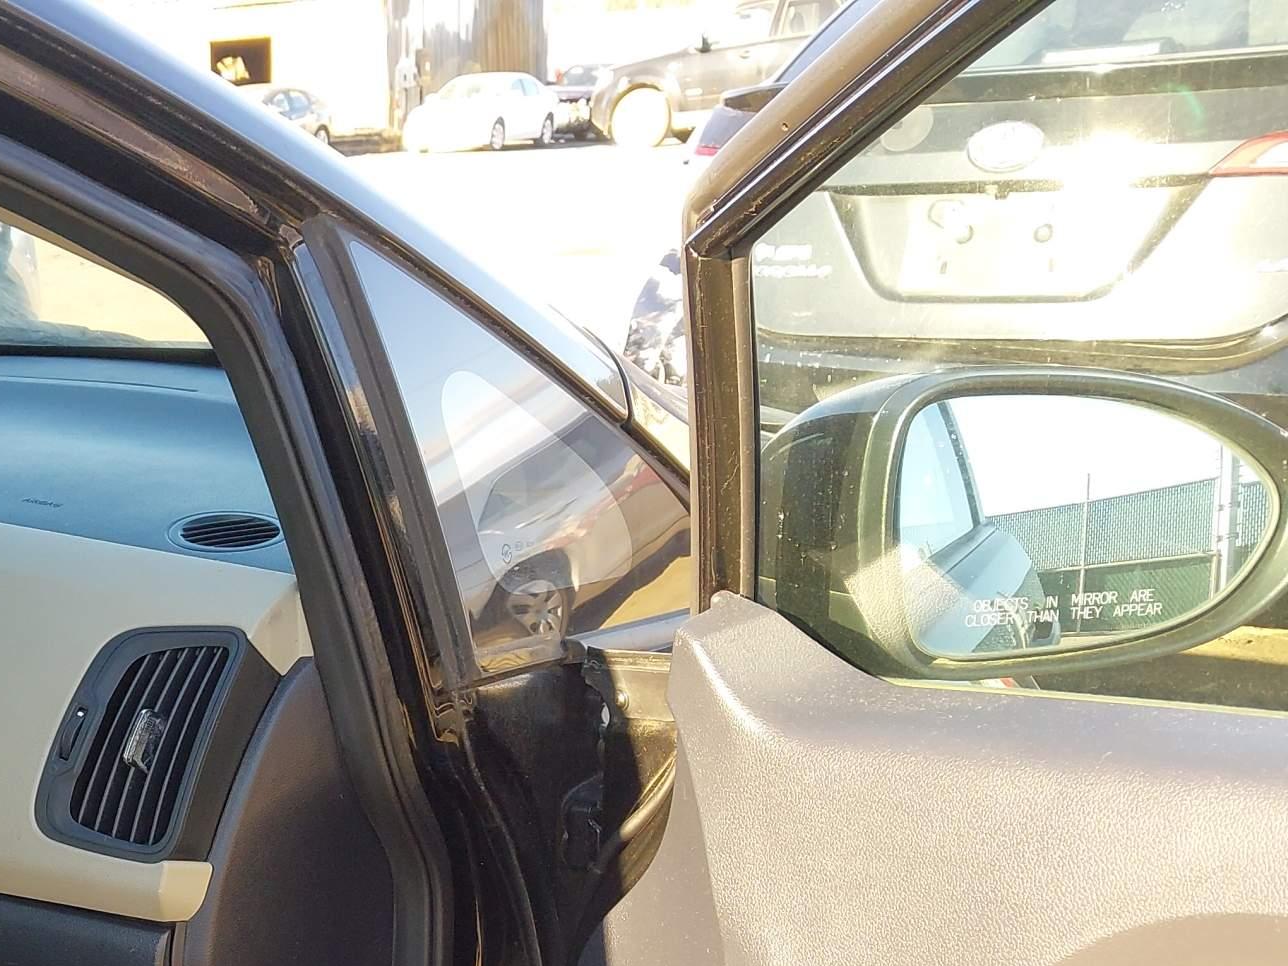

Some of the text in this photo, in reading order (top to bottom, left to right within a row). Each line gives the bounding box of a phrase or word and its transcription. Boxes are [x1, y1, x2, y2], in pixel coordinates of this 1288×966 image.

[974, 589, 1155, 612] OBJECTS IN MIRROR ARE
[965, 602, 1162, 627] CLOSER THAN THEY APPEAR
